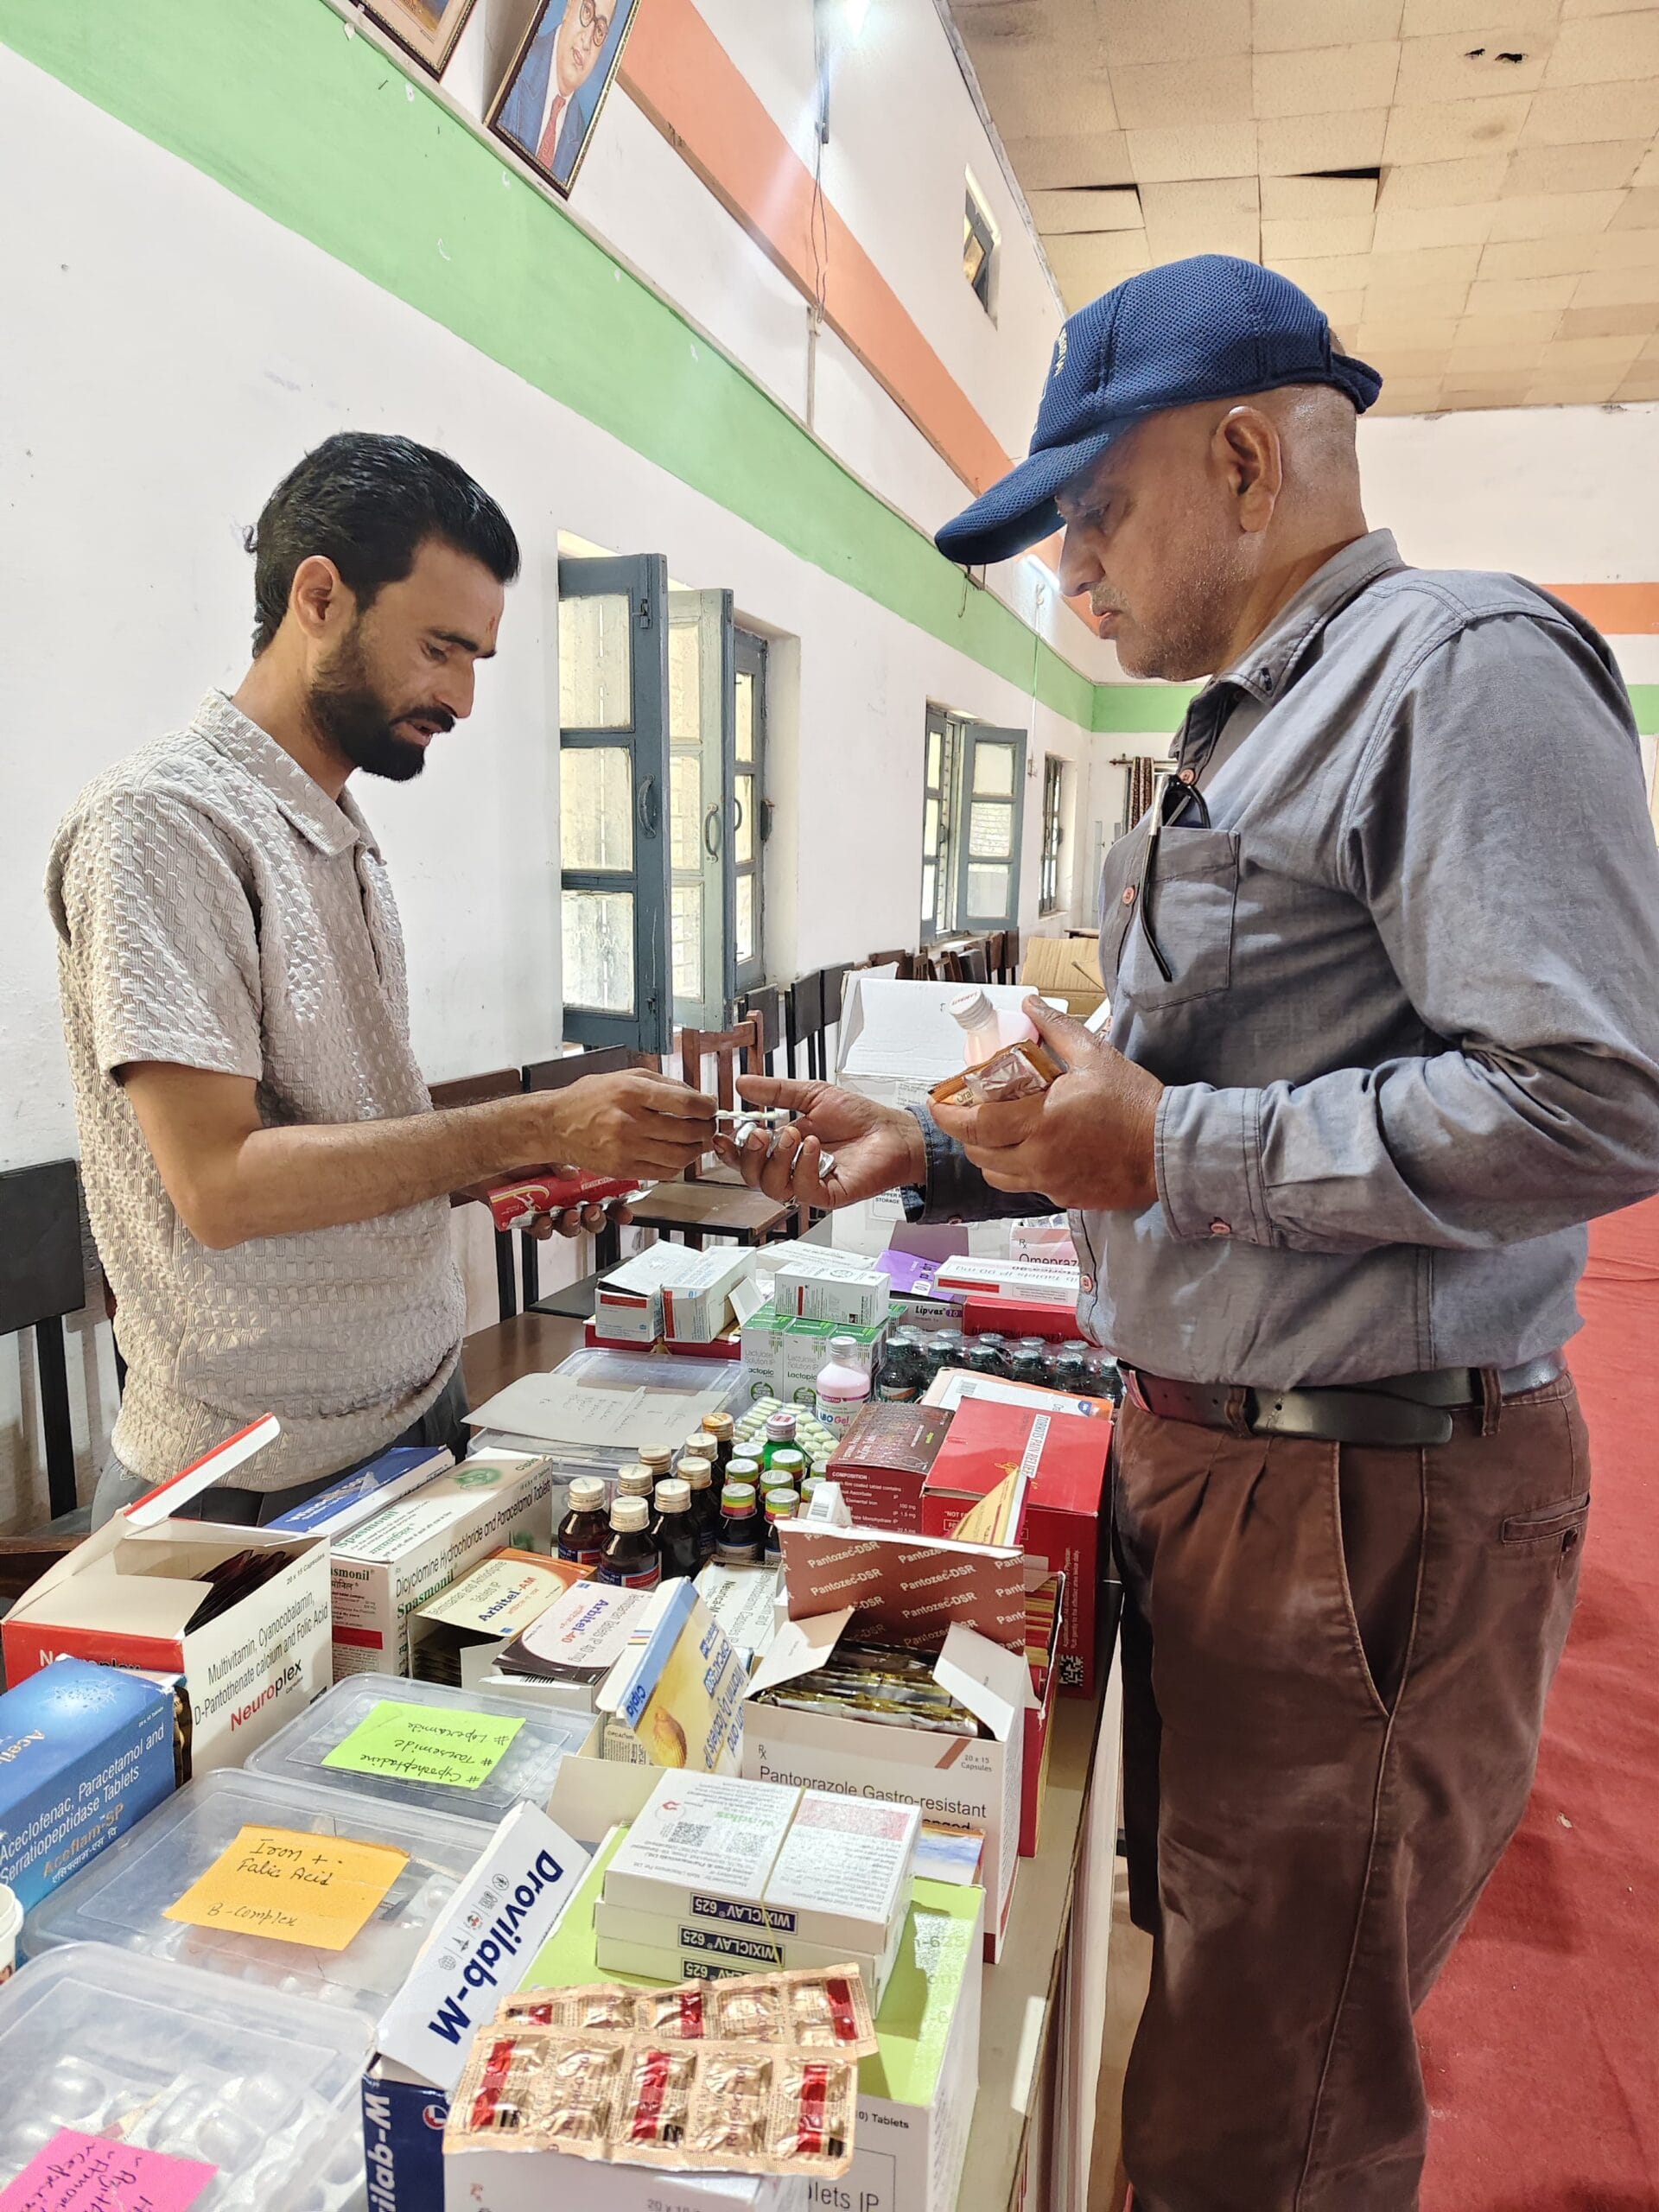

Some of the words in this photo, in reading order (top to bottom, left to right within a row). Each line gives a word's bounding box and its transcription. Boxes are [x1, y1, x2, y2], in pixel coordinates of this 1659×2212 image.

[396, 1557, 439, 1599] Dicyclomine
[439, 1527, 484, 1571] Hydrochloride
[483, 1517, 497, 1539] and
[496, 1491, 534, 1527] Paracetamol
[532, 1478, 551, 1503] Tablets
[396, 1567, 454, 1620] Spasmonil
[899, 1564, 977, 1592] Pantozec-DSR
[194, 1668, 256, 1726] D-Pantothenate
[255, 1644, 283, 1677] calcium
[283, 1630, 297, 1653] and
[296, 1621, 313, 1643] Folic
[313, 1601, 329, 1630] Acid
[207, 1637, 258, 1686] Multivitamin,
[258, 1590, 315, 1649] Cyanocobalamin,
[229, 1658, 303, 1732] Neuroplex
[626, 1685, 646, 1718] Cipla
[0, 1796, 75, 1861] Aceclofenac,
[78, 1742, 143, 1802] Paracetamol
[145, 1723, 164, 1751] and
[759, 1765, 858, 1796] Pantoprazole
[862, 1784, 988, 1819] Gastro-resistant
[960, 1762, 993, 1772] Capsules
[0, 1796, 100, 1887] Serratiopeptidase
[102, 1765, 140, 1803] Tablets
[694, 1897, 719, 1914] 625
[427, 1848, 565, 2046] Drovilab-M
[682, 1929, 706, 1946] 625
[685, 1963, 709, 1980] 625
[871, 2112, 910, 2130] Tablets
[859, 2190, 880, 2212] IP
